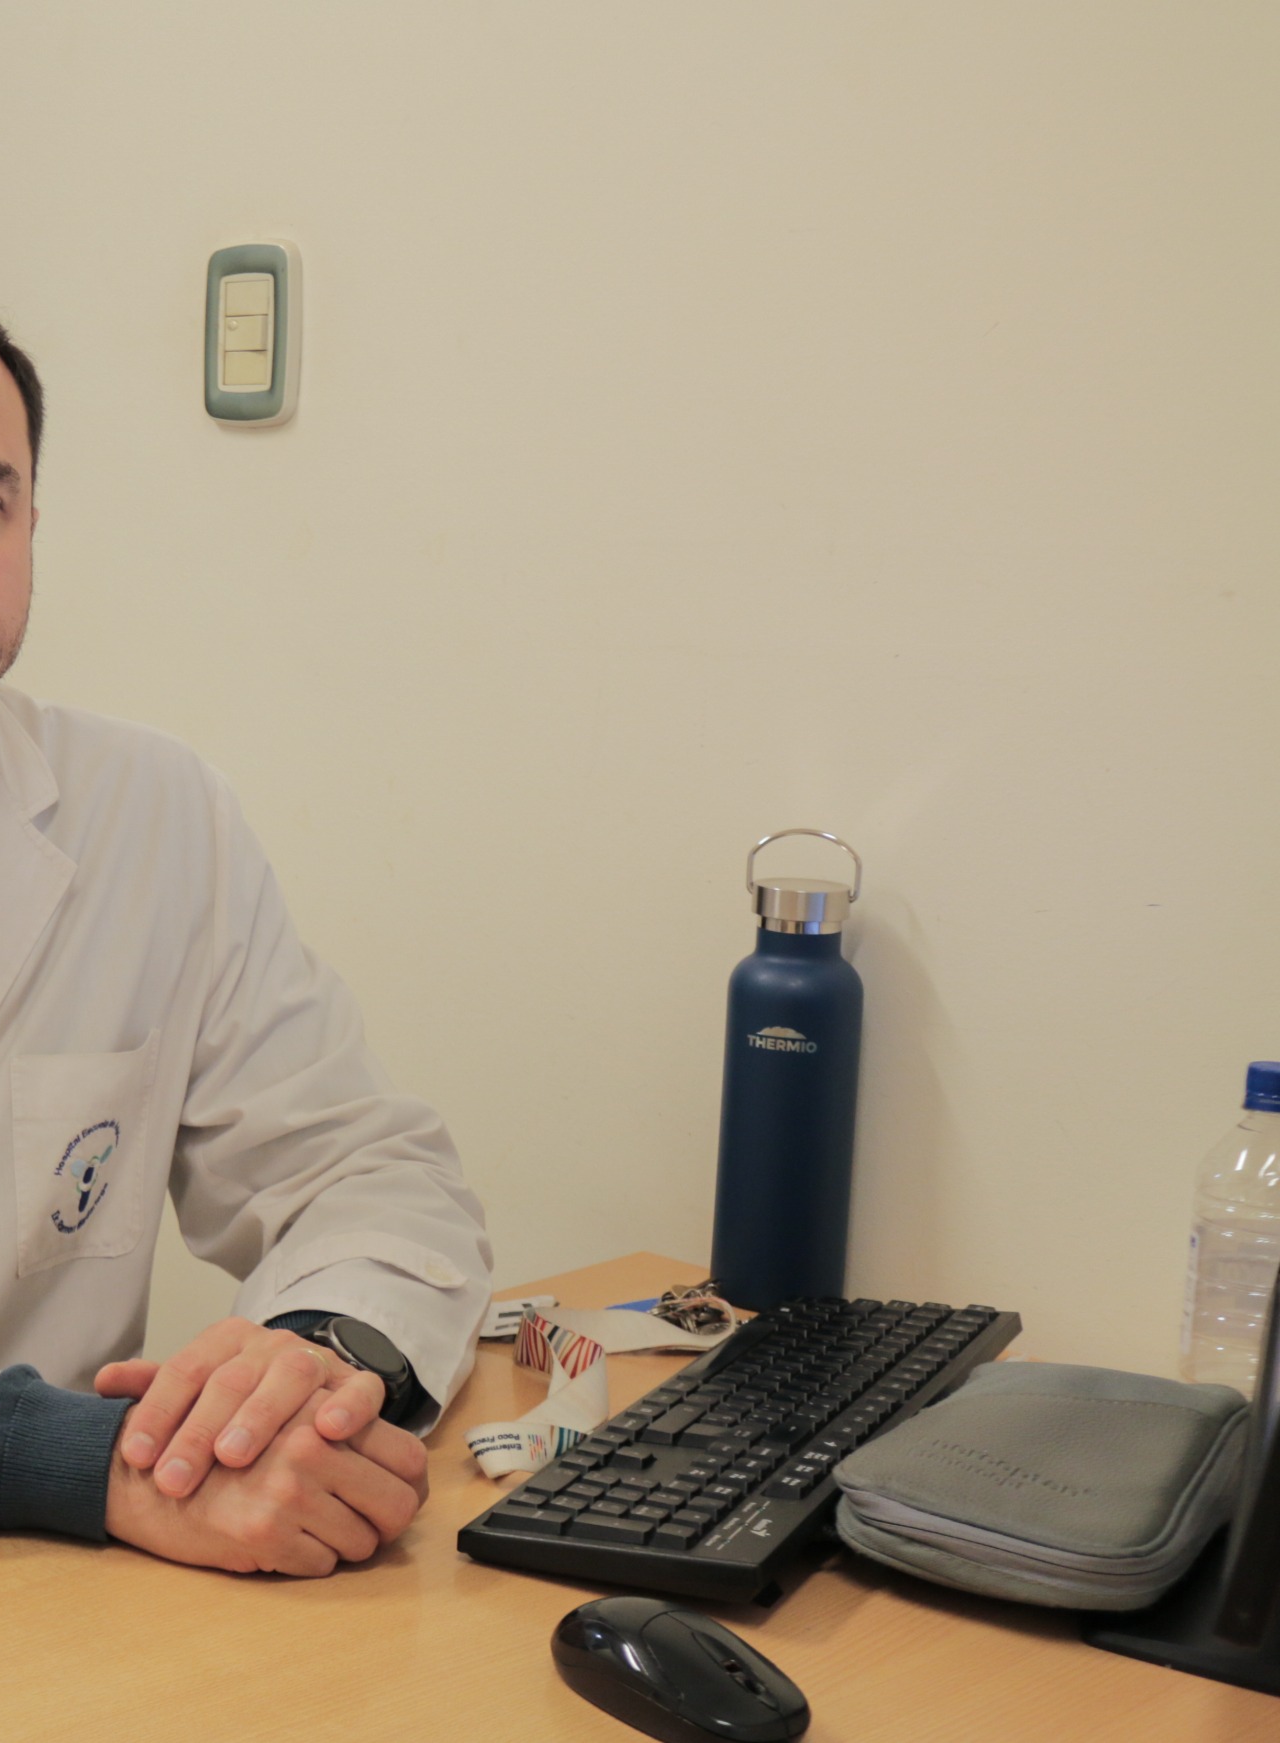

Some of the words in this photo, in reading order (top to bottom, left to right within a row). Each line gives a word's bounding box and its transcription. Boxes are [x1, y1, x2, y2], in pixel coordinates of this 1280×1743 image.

[747, 1034, 818, 1054] THERMIO
[54, 1134, 81, 1176] Hospital
[497, 1433, 520, 1441] Poco
